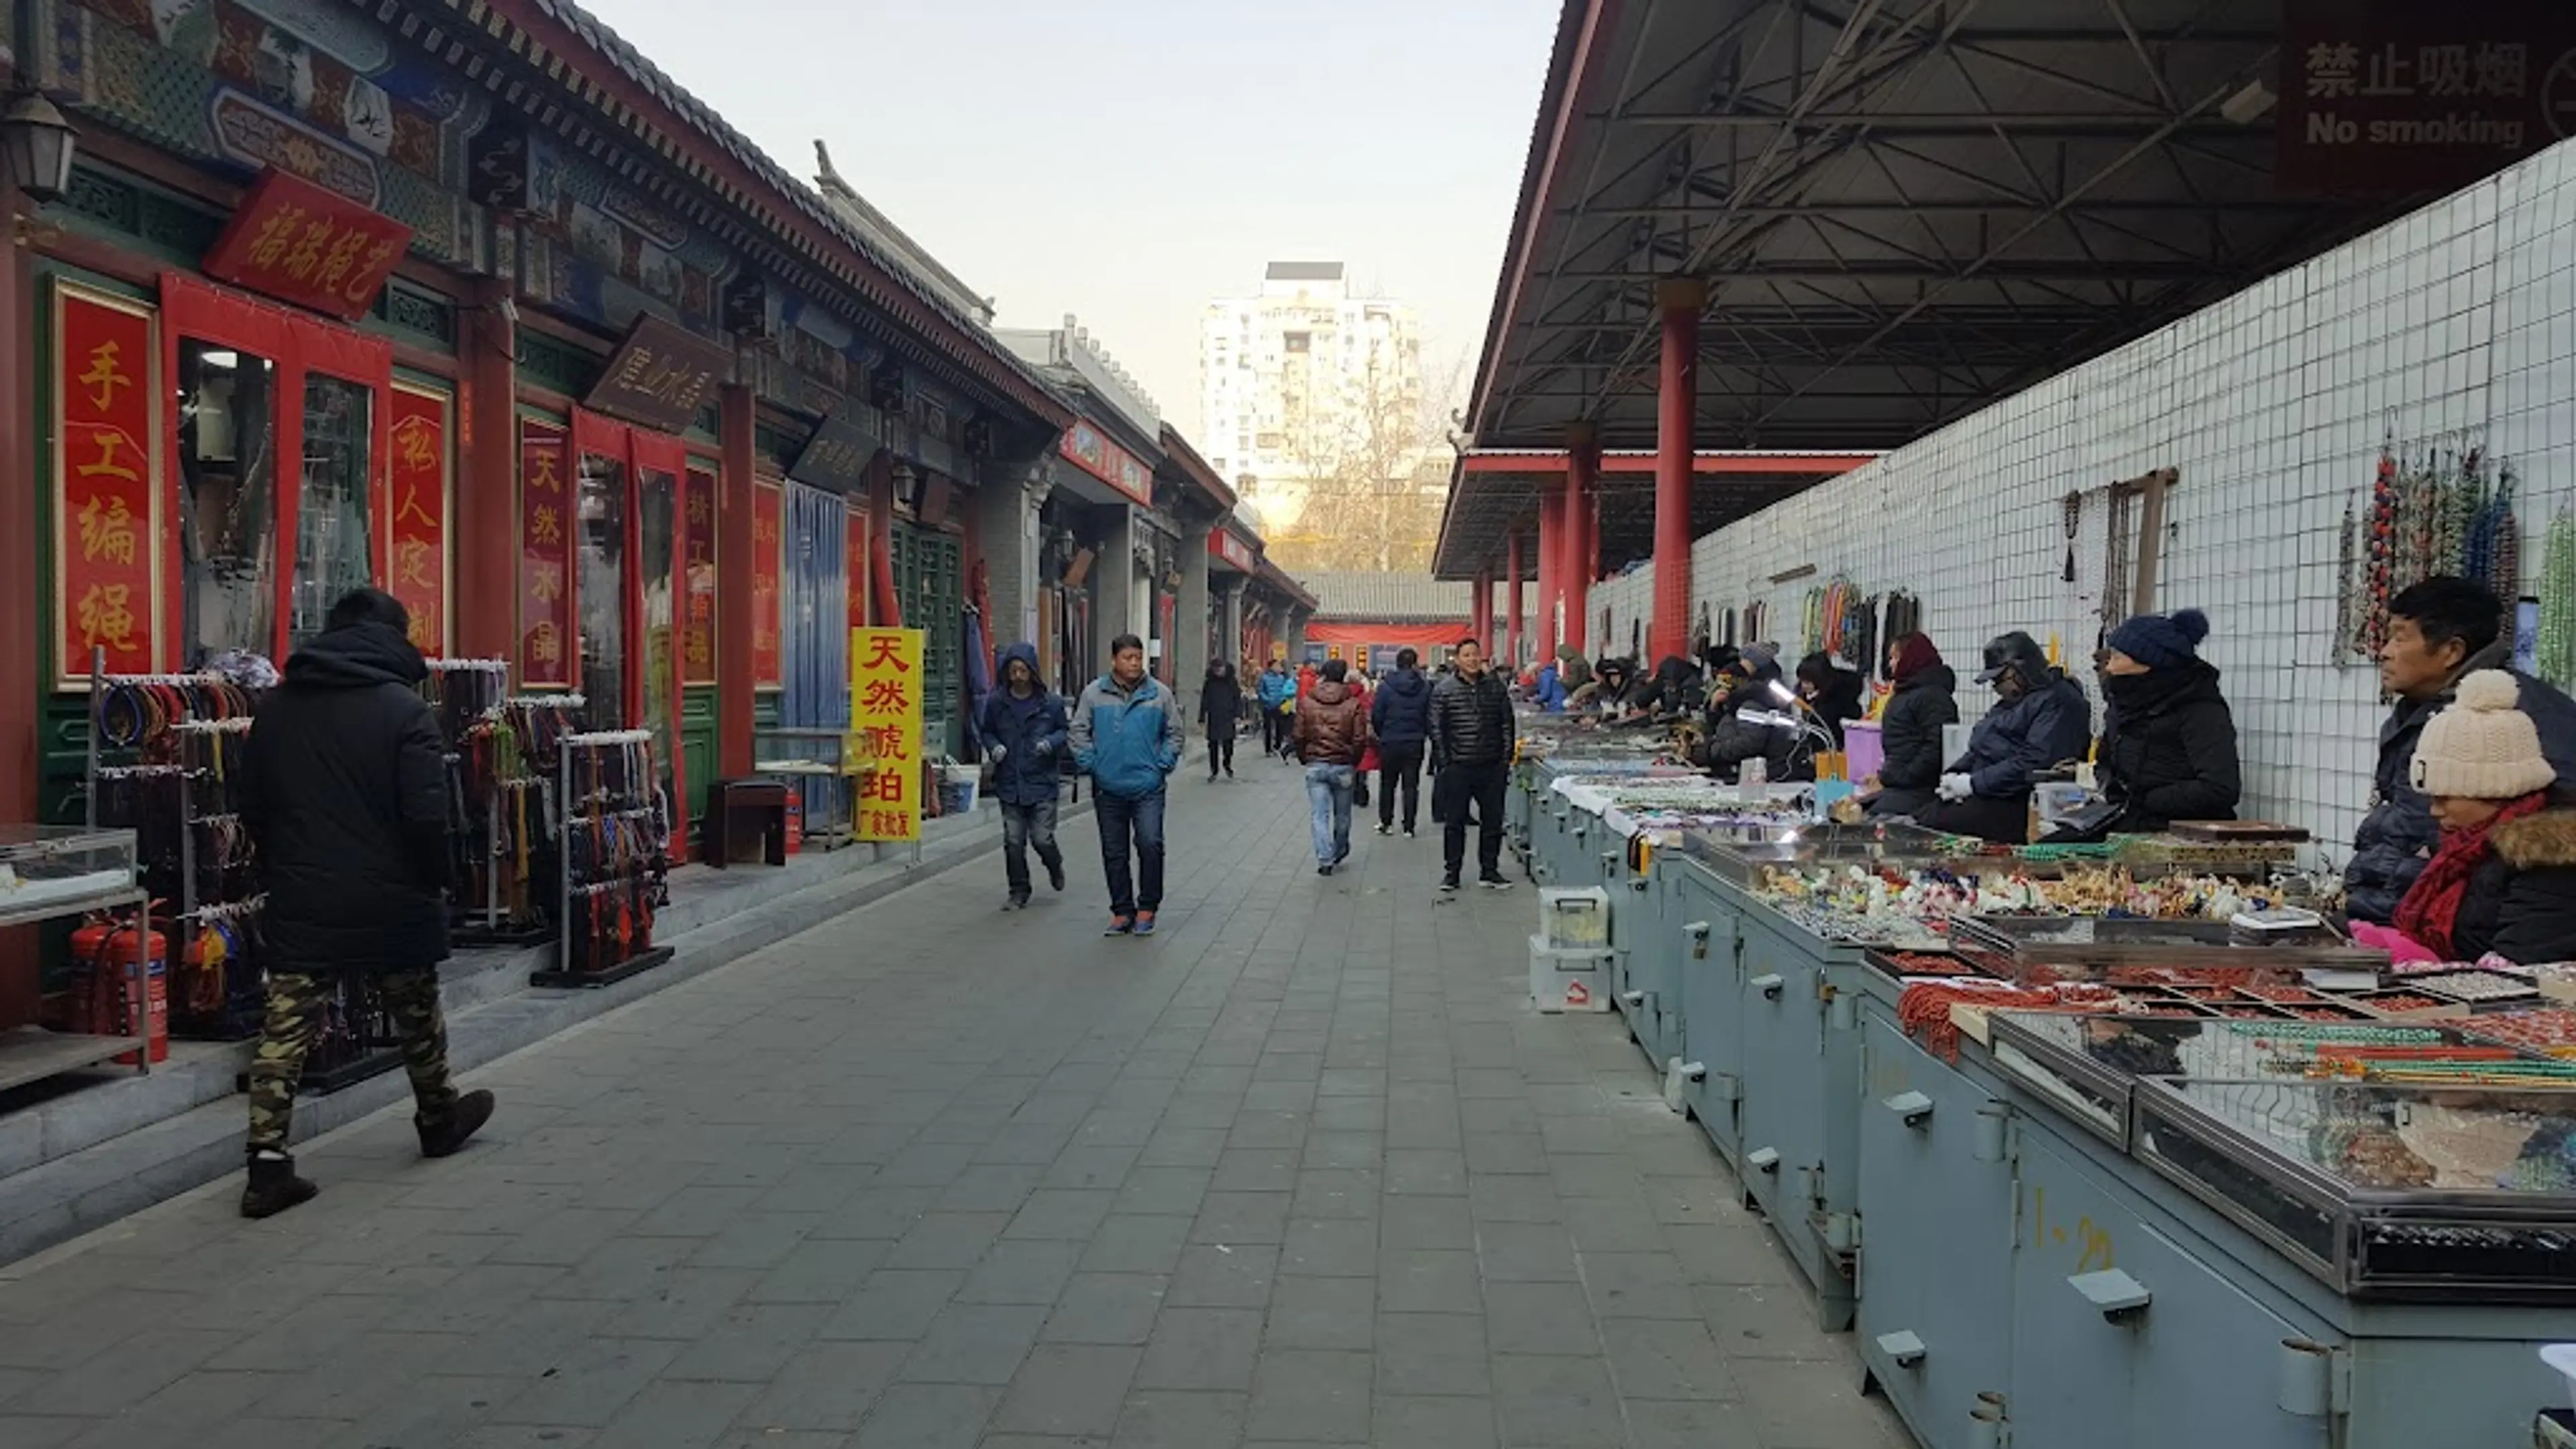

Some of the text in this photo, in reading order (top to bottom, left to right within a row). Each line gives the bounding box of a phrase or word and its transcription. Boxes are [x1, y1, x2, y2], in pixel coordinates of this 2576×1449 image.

[2305, 42, 2527, 98] 禁止吸烟
[2306, 111, 2524, 149] No smoking
[76, 338, 139, 653] 手工编绳
[398, 416, 438, 655] 私人定制
[530, 448, 561, 663] 天然水晶
